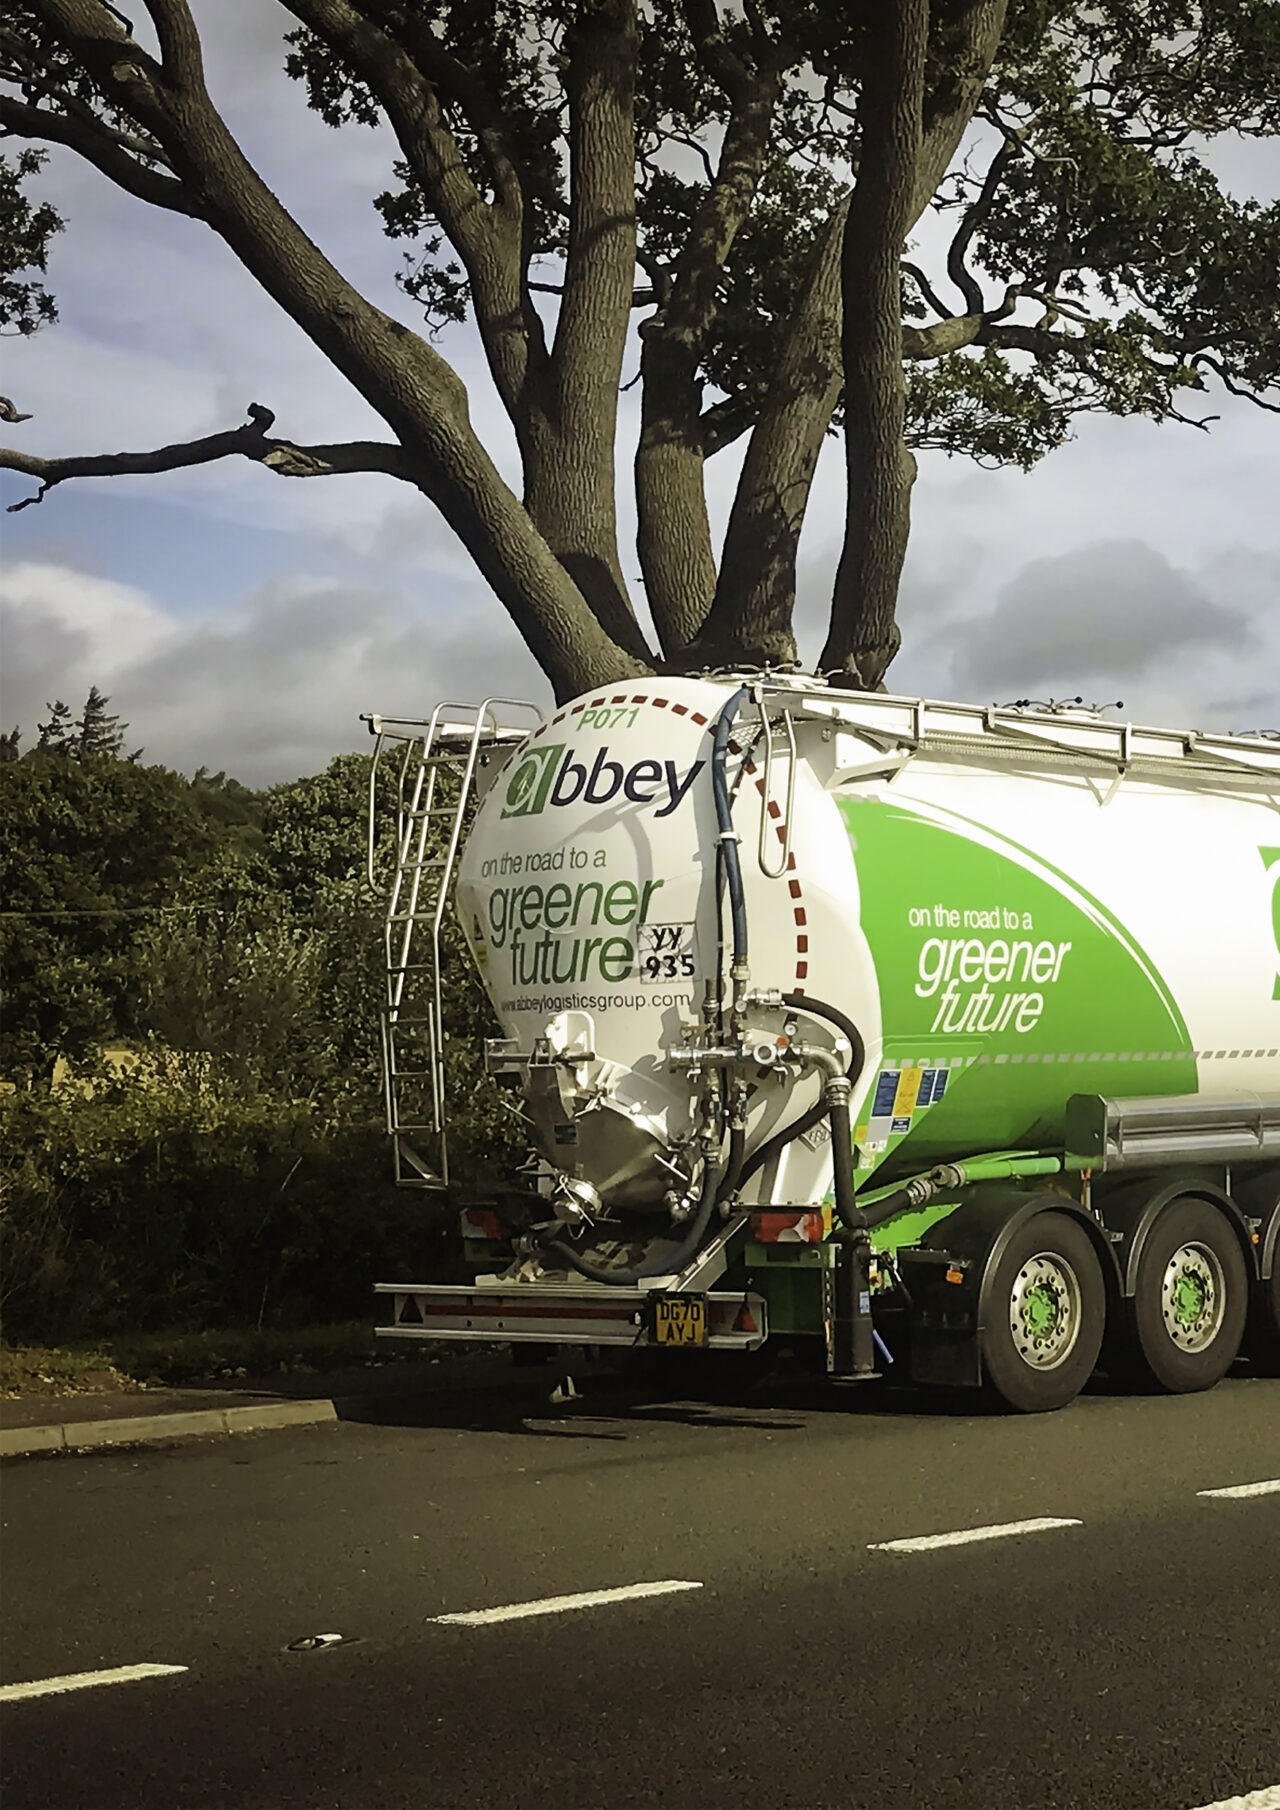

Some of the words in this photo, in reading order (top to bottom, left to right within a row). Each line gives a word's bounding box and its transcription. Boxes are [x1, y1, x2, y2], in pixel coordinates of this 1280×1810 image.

[576, 707, 640, 732] P071
[500, 743, 707, 820] abbey
[481, 858, 497, 878] on
[501, 851, 522, 876] the
[525, 847, 565, 872] road
[570, 847, 588, 869] to
[593, 849, 607, 868] a
[489, 879, 664, 949] greener
[908, 907, 931, 927] on
[934, 904, 961, 928] the
[964, 906, 1000, 929] road
[1003, 907, 1019, 930] to
[1022, 911, 1033, 930] a
[511, 927, 635, 986] future
[646, 954, 696, 979] 935
[915, 937, 1072, 998] greener
[930, 978, 1044, 1033] future
[661, 1302, 701, 1322] DG70
[666, 1322, 696, 1341] AYJ
